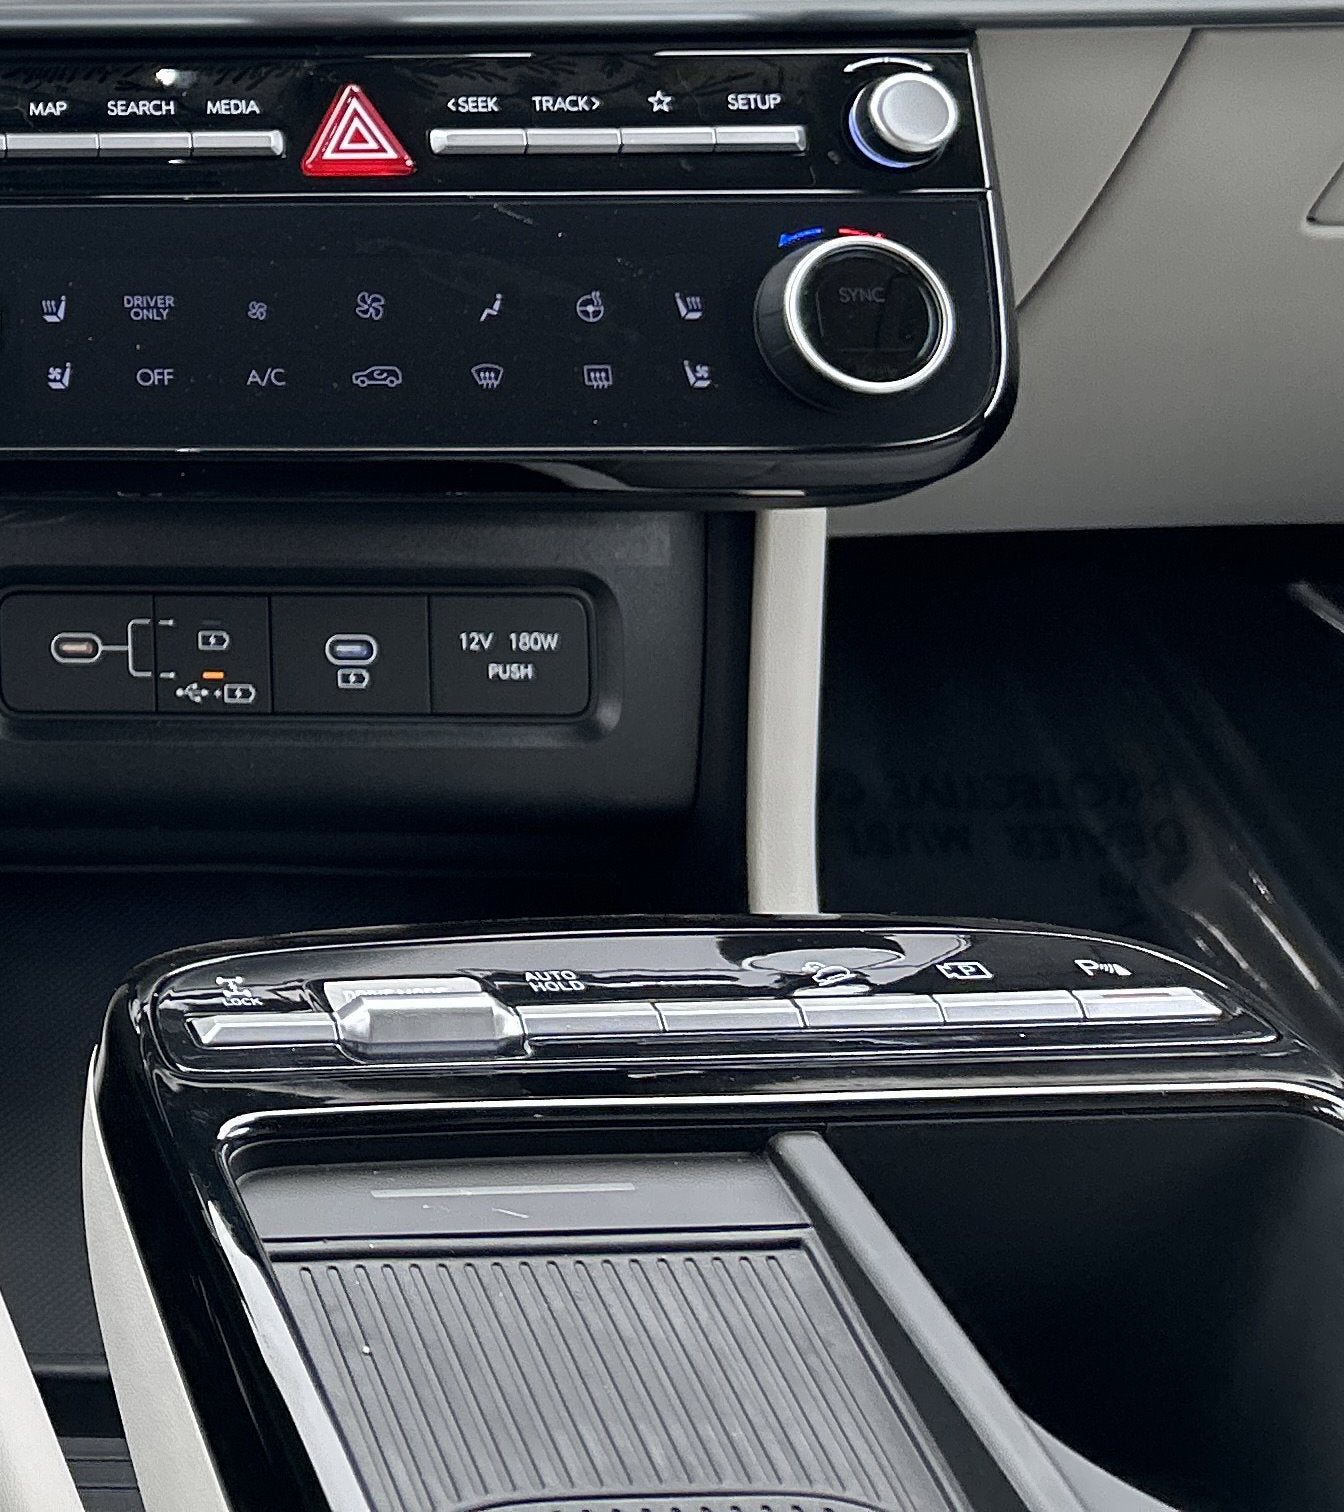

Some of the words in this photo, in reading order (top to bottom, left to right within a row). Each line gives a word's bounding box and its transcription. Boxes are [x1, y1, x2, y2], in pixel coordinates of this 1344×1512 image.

[30, 101, 67, 116] MAP
[108, 100, 174, 115] SEARCH
[207, 100, 260, 114] MEDIA
[728, 94, 781, 110] SETUP
[124, 296, 174, 307] DRIVER
[839, 287, 885, 304] SYNC
[131, 308, 168, 320] ONLY
[137, 369, 173, 386] OFF
[247, 368, 285, 386] A/C
[460, 632, 493, 650] 12V
[510, 632, 558, 651] 180W
[489, 664, 532, 679] PUSH
[524, 970, 575, 982] AUTO
[529, 980, 585, 992] HOLD
[223, 996, 263, 1007] LOCK
